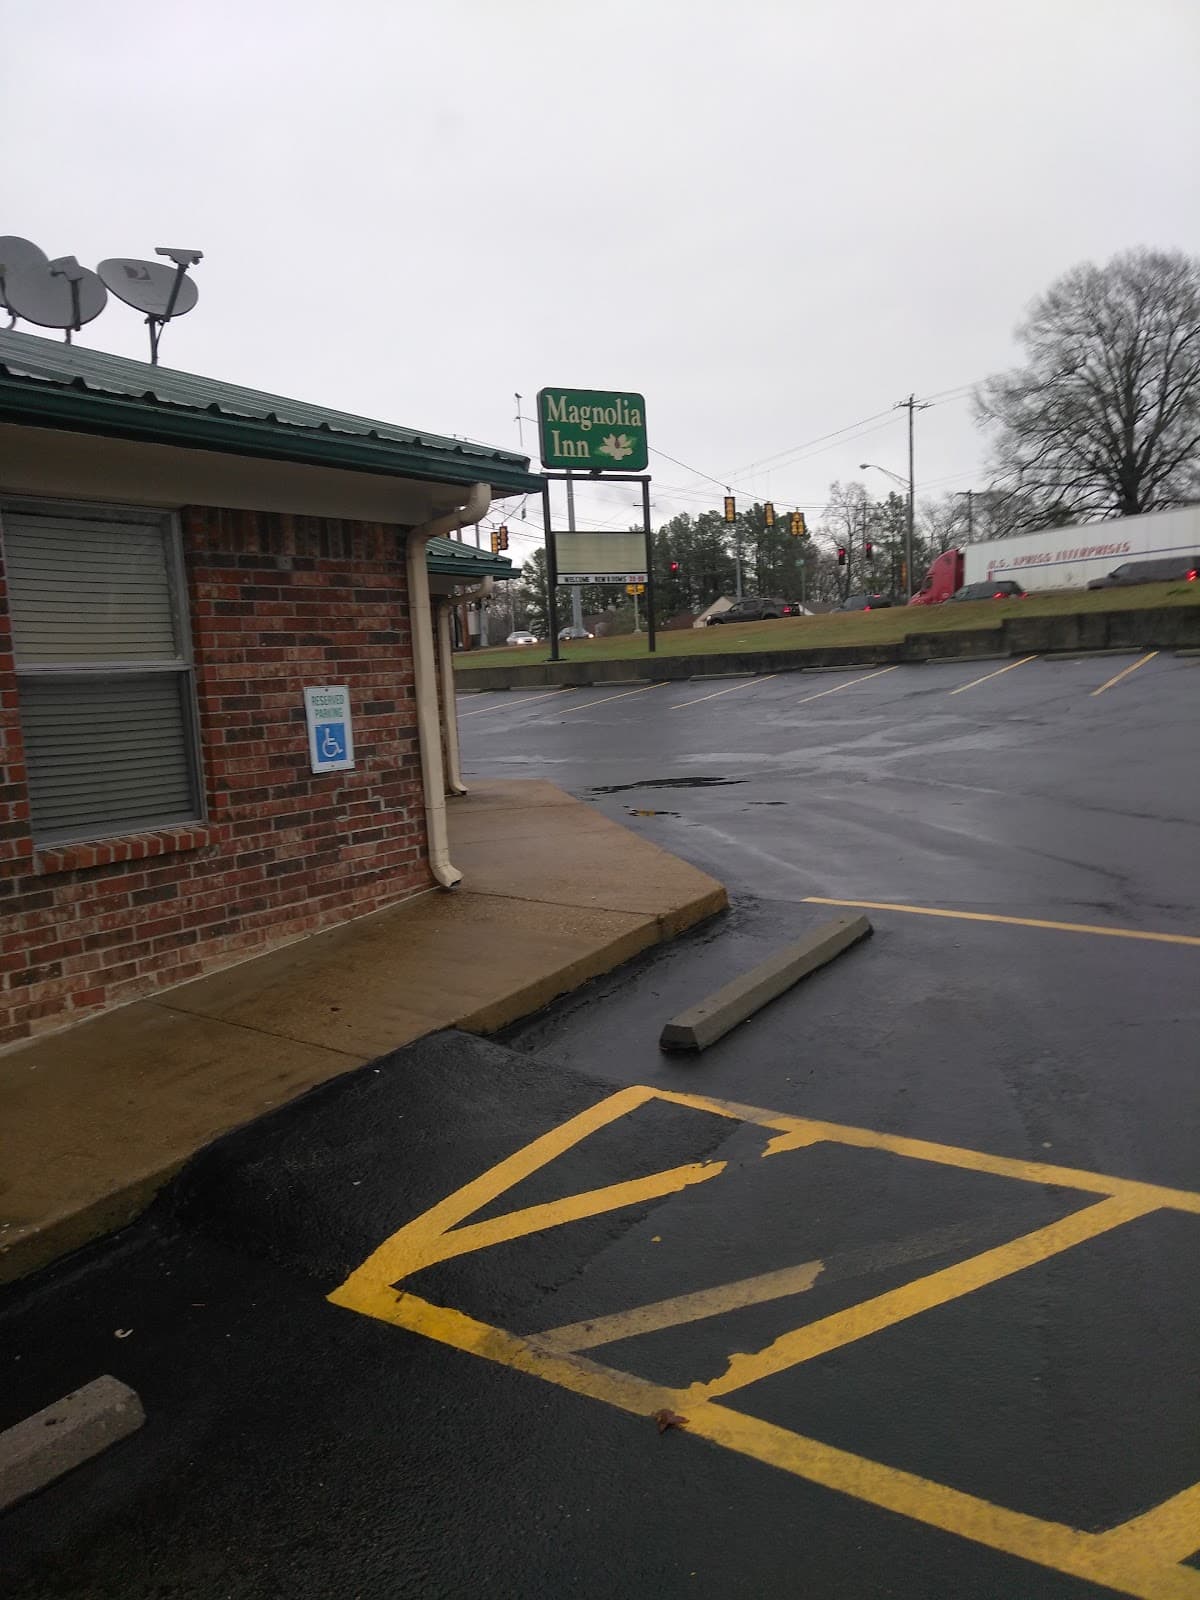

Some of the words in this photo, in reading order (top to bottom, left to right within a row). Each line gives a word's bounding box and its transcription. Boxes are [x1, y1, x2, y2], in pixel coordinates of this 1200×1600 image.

[545, 395, 642, 430] Magnolia
[552, 430, 591, 458] Inn
[311, 694, 344, 705] RESERVED
